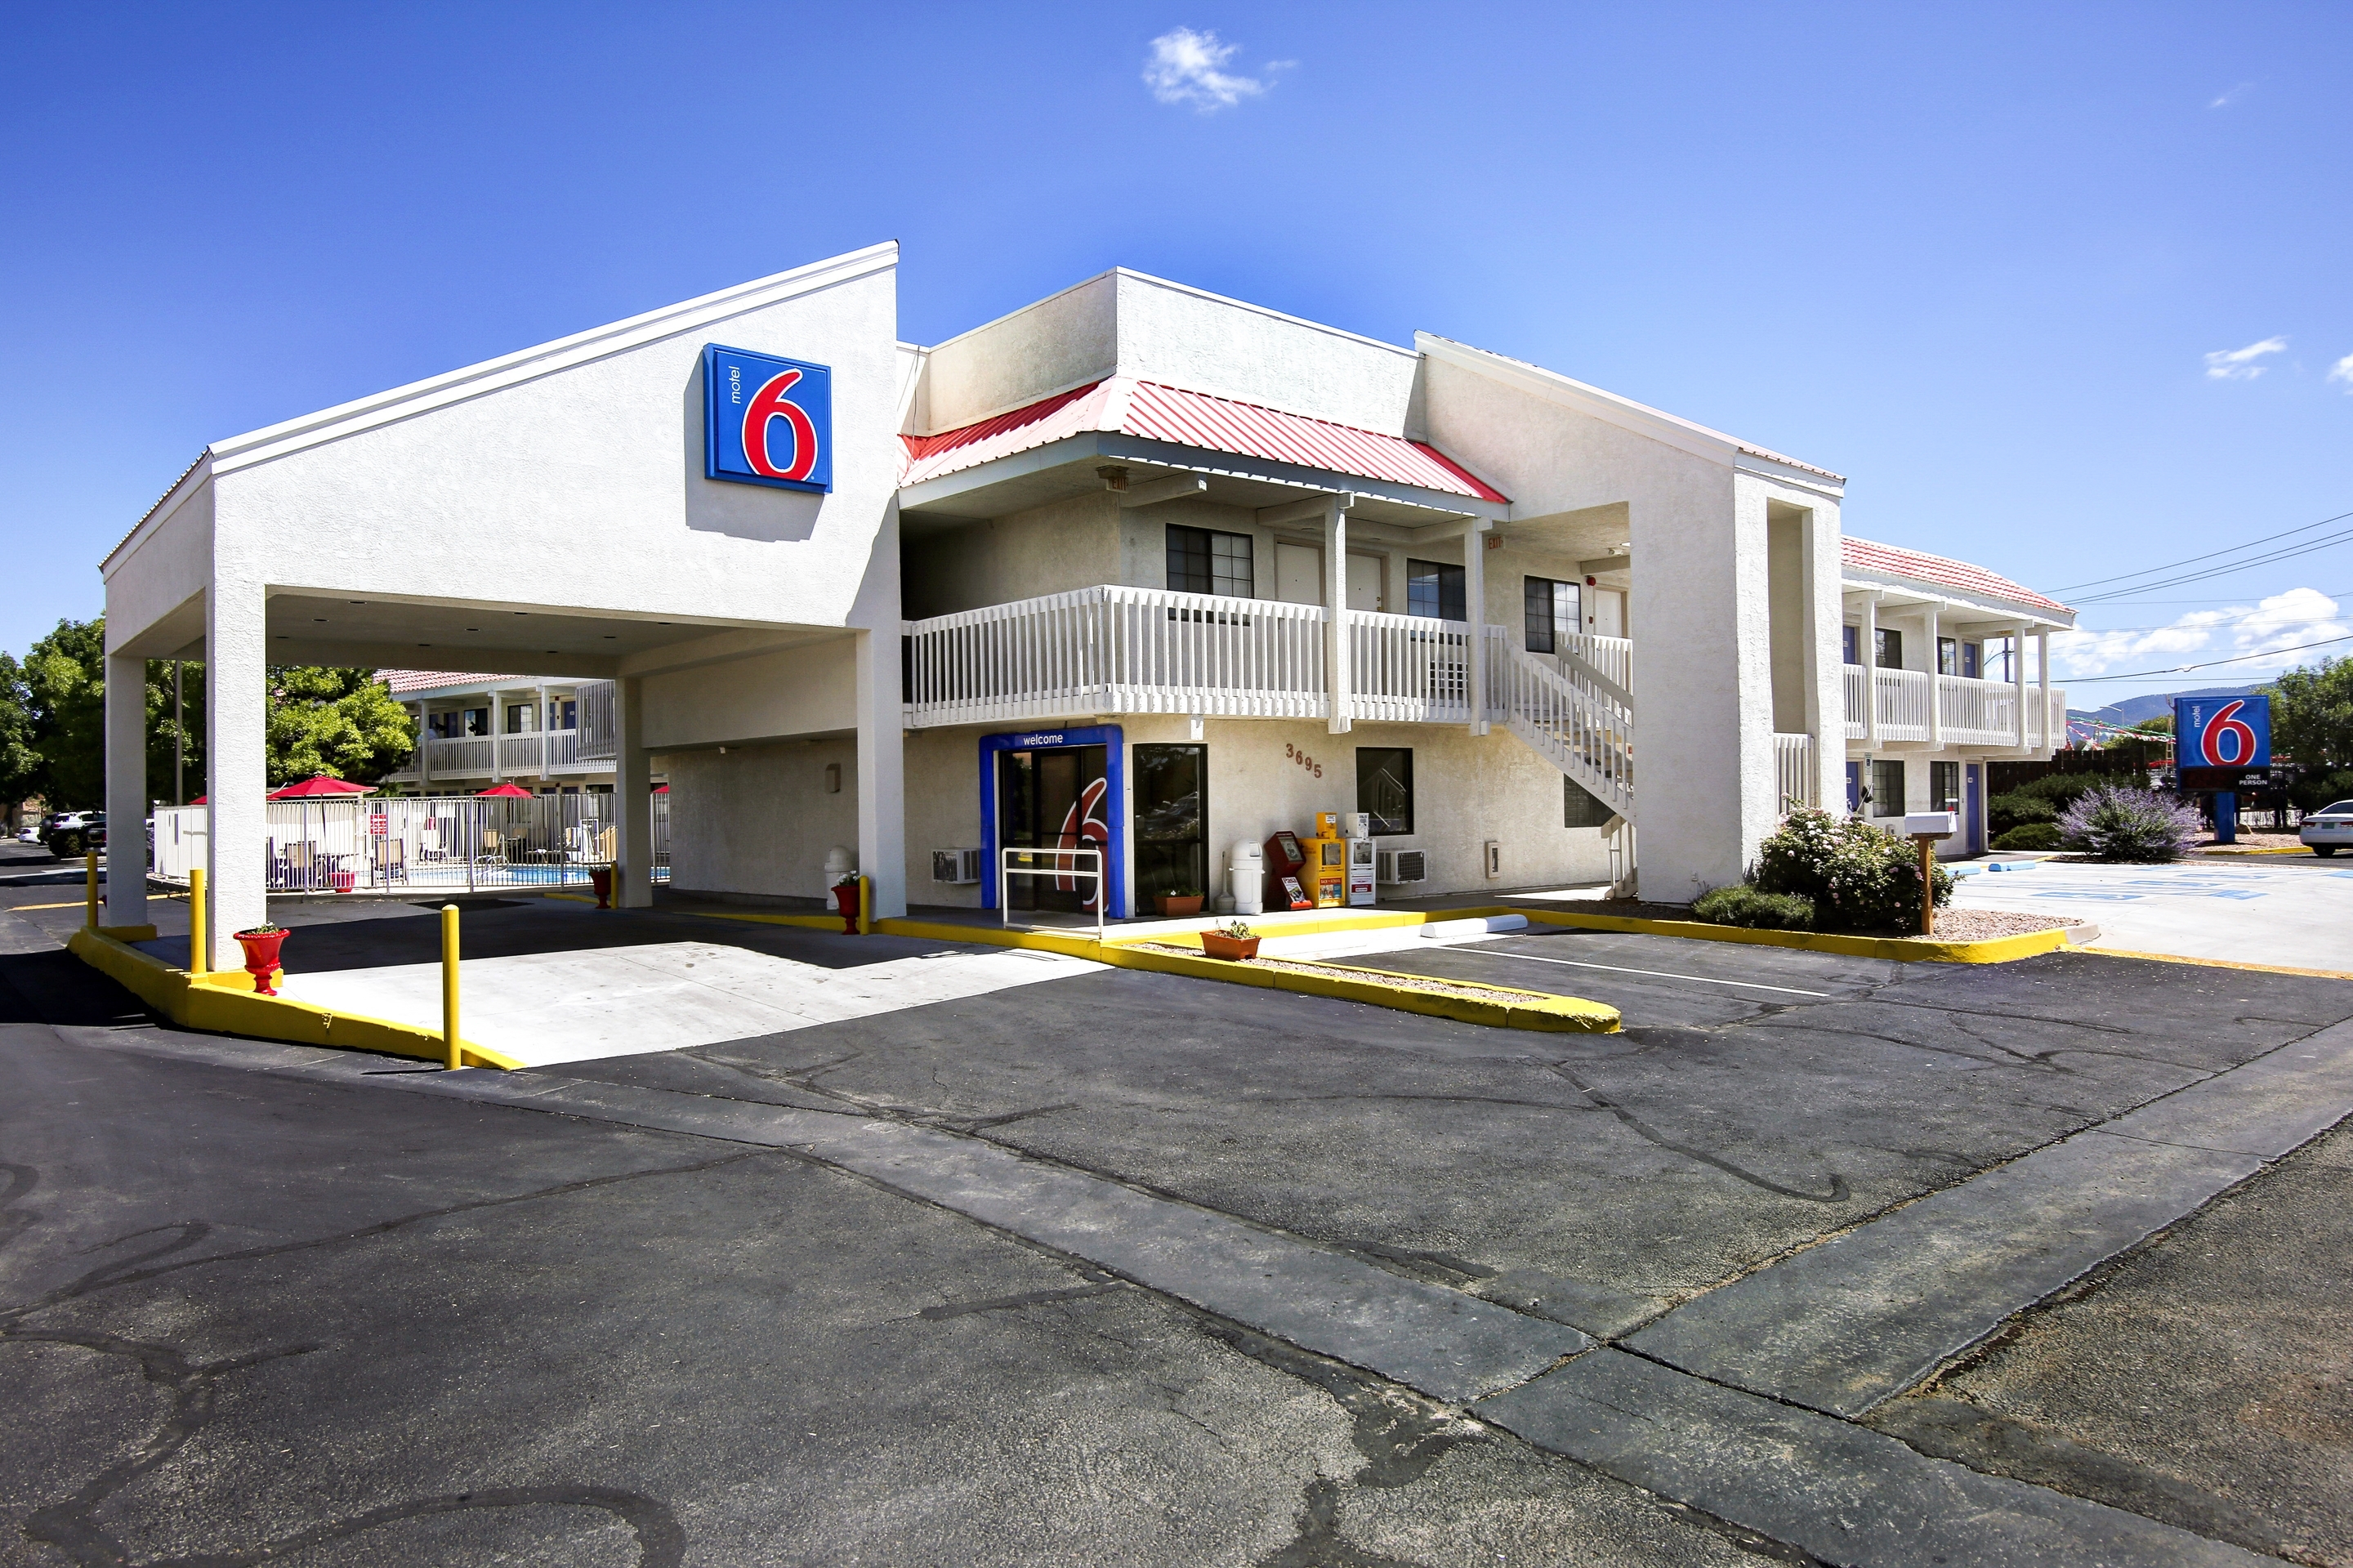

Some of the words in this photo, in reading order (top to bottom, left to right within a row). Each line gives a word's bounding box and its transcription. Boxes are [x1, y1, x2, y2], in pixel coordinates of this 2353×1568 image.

[729, 366, 741, 404] motel
[741, 368, 819, 481] 6
[1112, 476, 1126, 491] EXIT
[1488, 536, 1501, 549] EXIT
[1023, 734, 1064, 745] welcome
[2192, 706, 2201, 728] motel
[2201, 699, 2257, 766] 6
[1286, 743, 1323, 779] 3695
